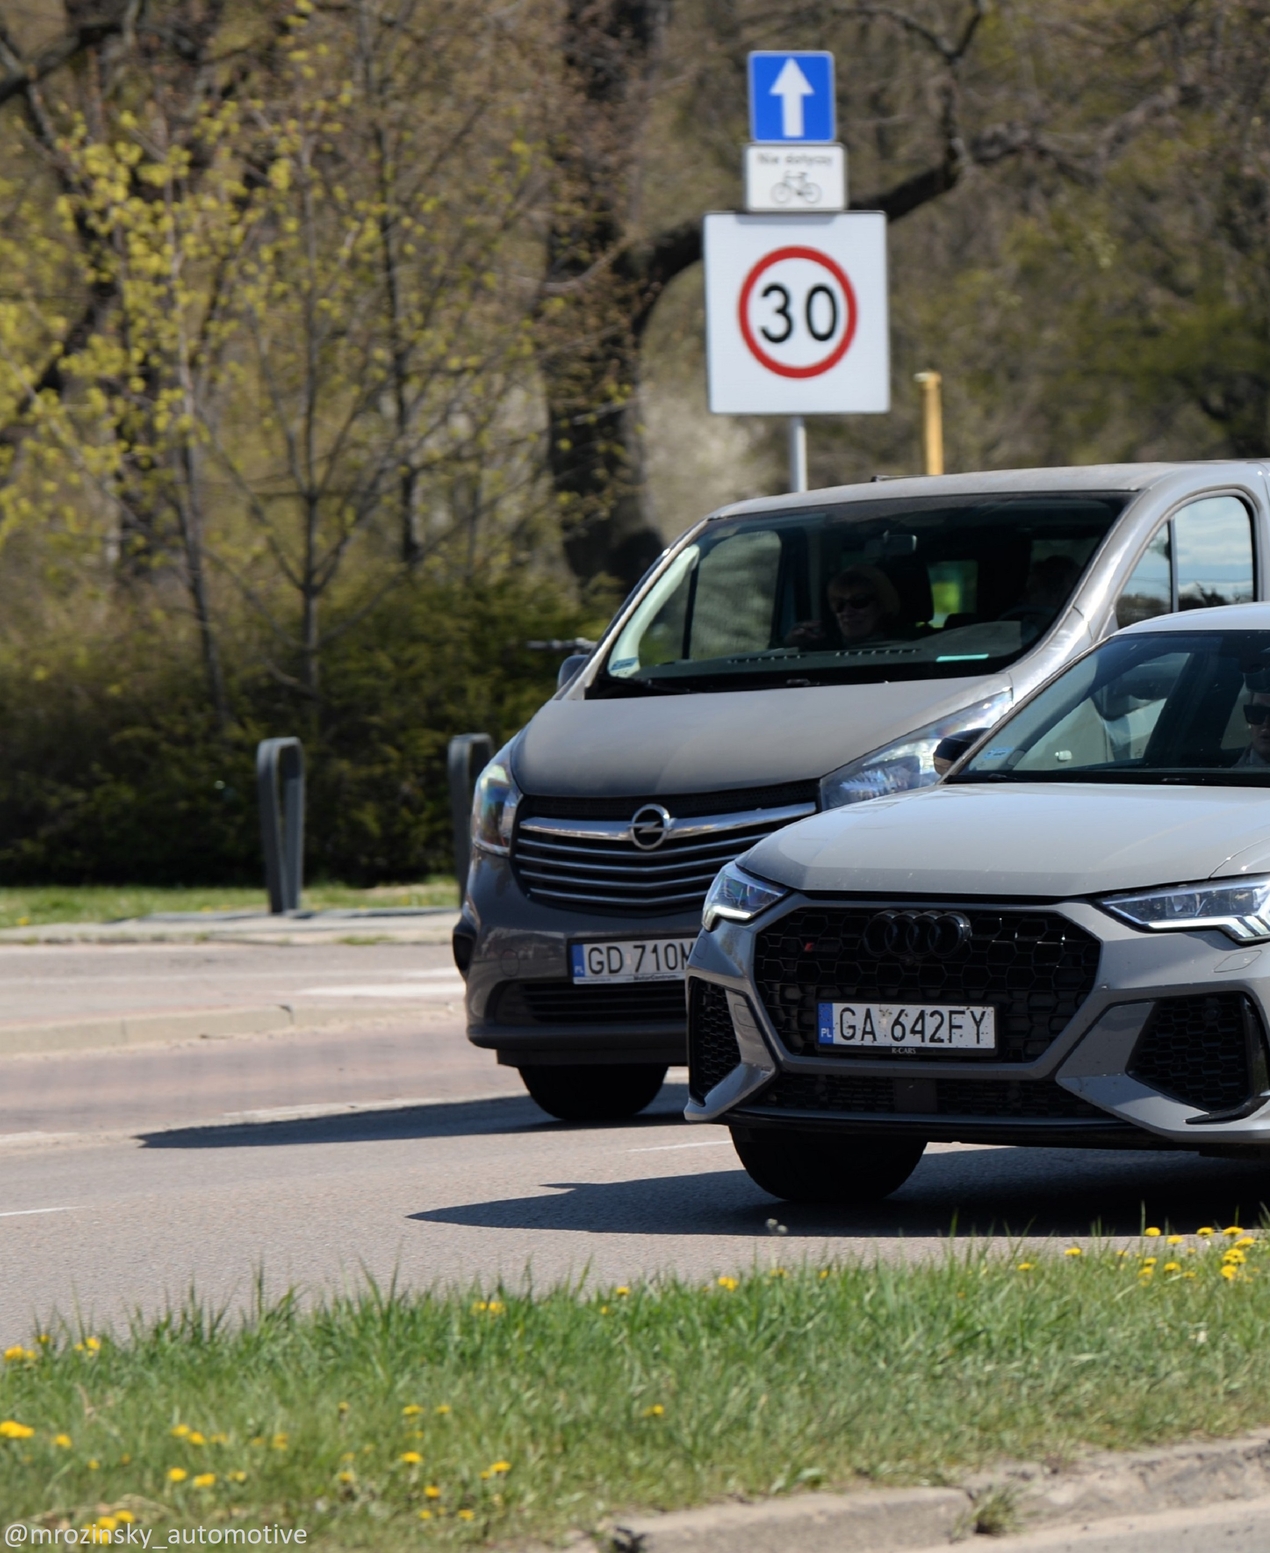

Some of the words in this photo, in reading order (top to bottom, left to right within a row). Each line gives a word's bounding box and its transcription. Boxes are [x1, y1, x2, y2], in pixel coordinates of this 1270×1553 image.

[760, 283, 838, 344] 30
[588, 945, 623, 975] GD
[820, 1028, 832, 1037] PL
[839, 1007, 877, 1042] GA
[890, 1008, 987, 1045] 642FY
